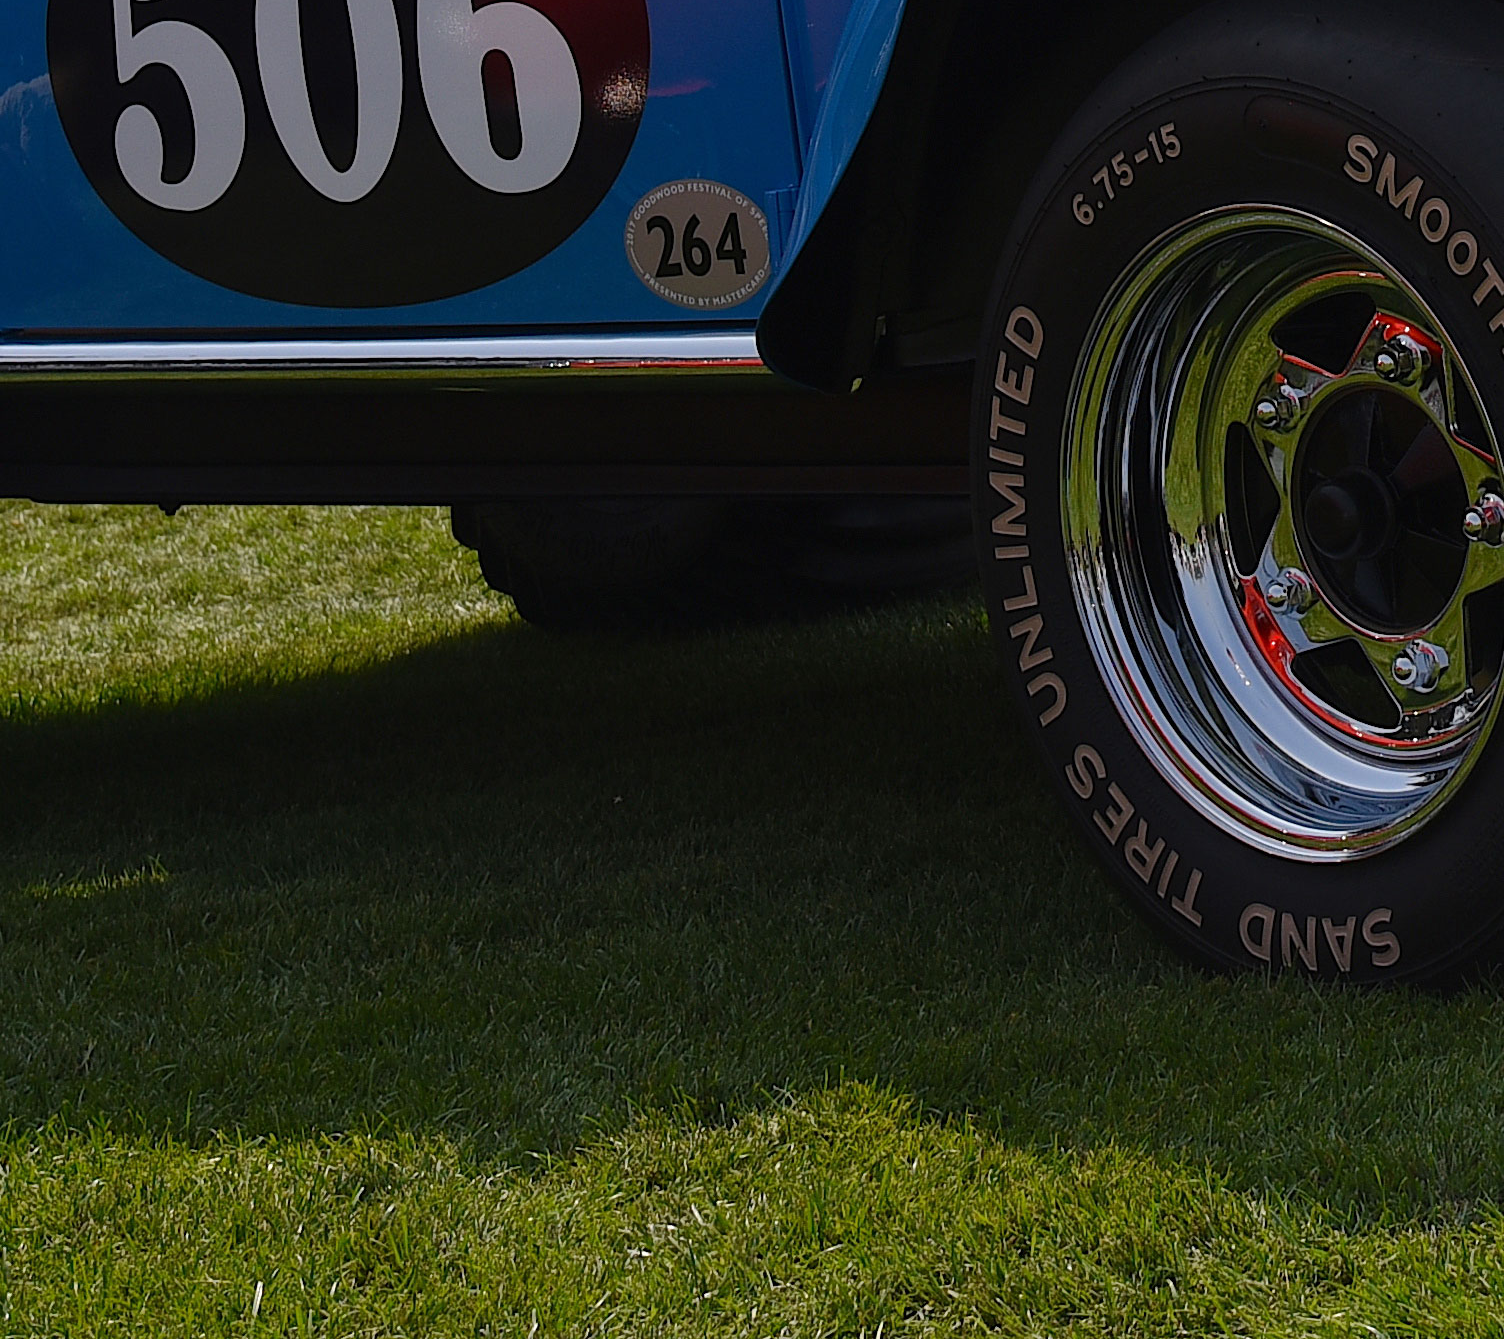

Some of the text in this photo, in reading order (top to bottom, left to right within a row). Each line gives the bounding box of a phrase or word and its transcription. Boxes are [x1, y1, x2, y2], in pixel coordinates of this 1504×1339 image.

[1071, 123, 1183, 226] 6.75-15
[626, 220, 635, 246] 2017
[634, 183, 685, 221] GOODWOOD
[687, 182, 732, 200] FESTIVAL
[735, 195, 749, 208] OF
[646, 212, 748, 278] 264
[643, 269, 766, 306] PRESENTED BY MASTERCARD
[988, 304, 1401, 973] SAND TIRES UNLIMITED
